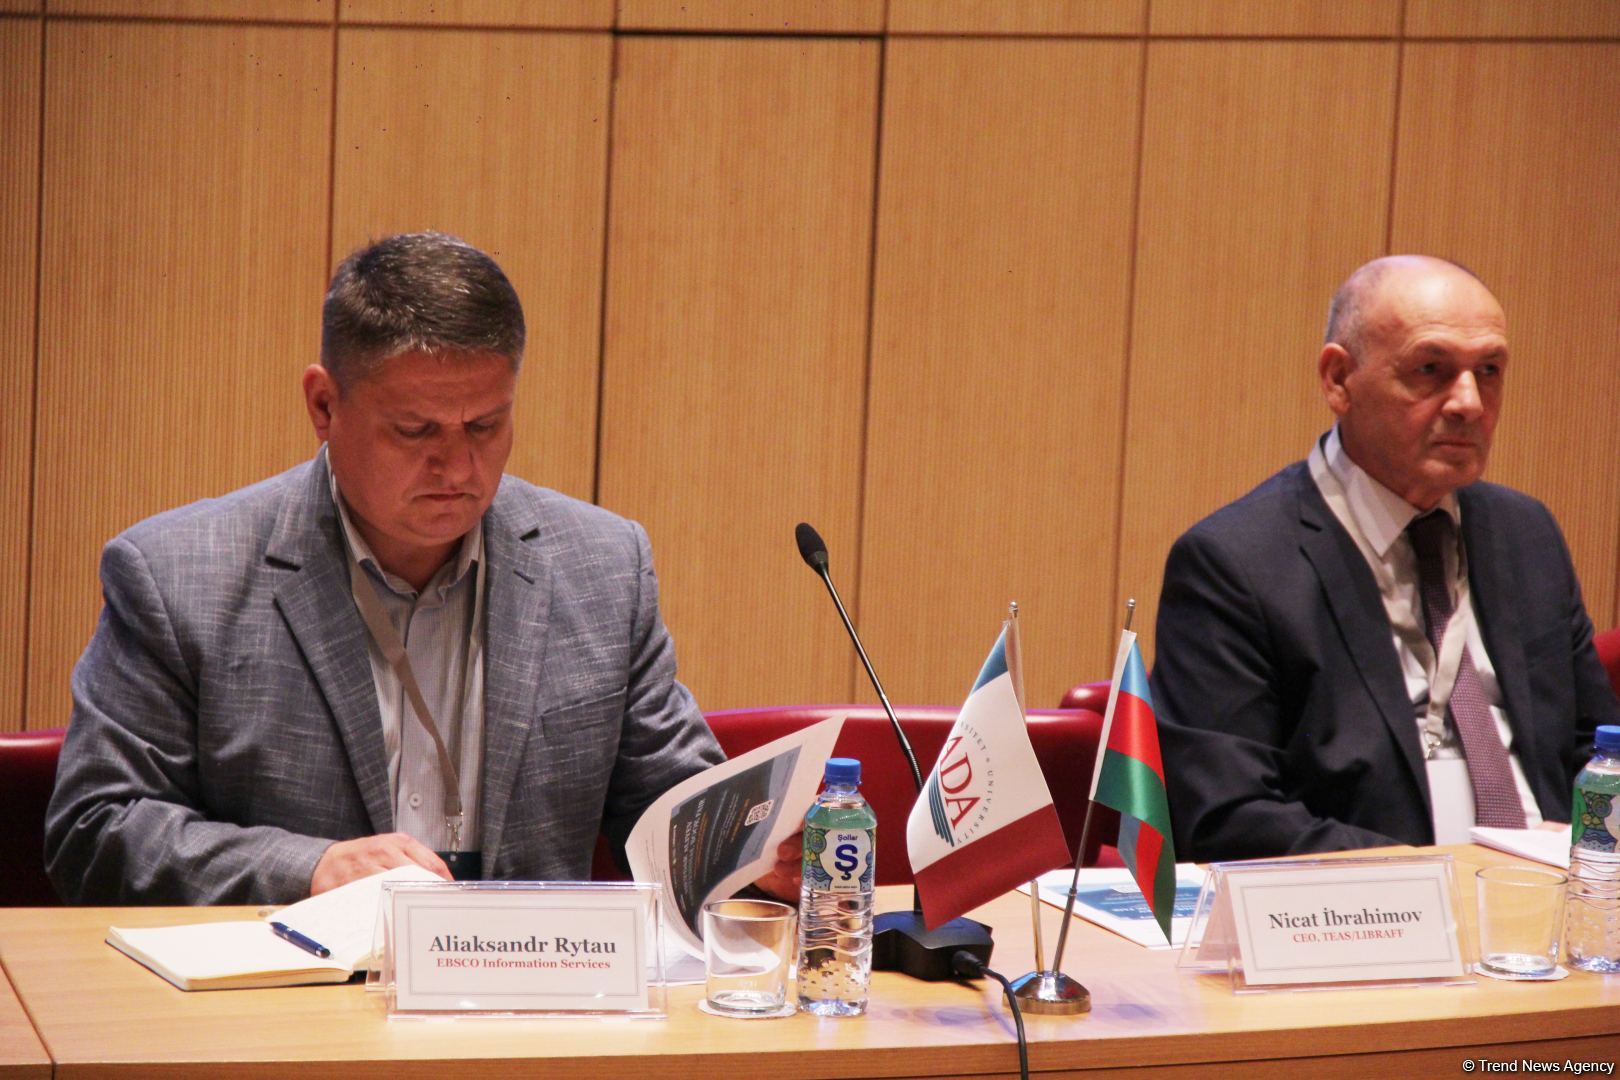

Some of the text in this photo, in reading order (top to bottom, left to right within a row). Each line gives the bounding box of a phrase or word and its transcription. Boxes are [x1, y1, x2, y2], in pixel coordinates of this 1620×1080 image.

[940, 736, 981, 831] ADA
[957, 770, 994, 844] UNIVERSITY
[838, 834, 858, 842] Şollar
[835, 844, 858, 880] Ş
[1269, 907, 1422, 929] Nicat İbrahimov
[430, 935, 616, 957] Aliaksandr Rytau
[1293, 929, 1404, 944] CEO, TEAS/LIBRAFF
[436, 958, 611, 969] EBSCO Information Services
